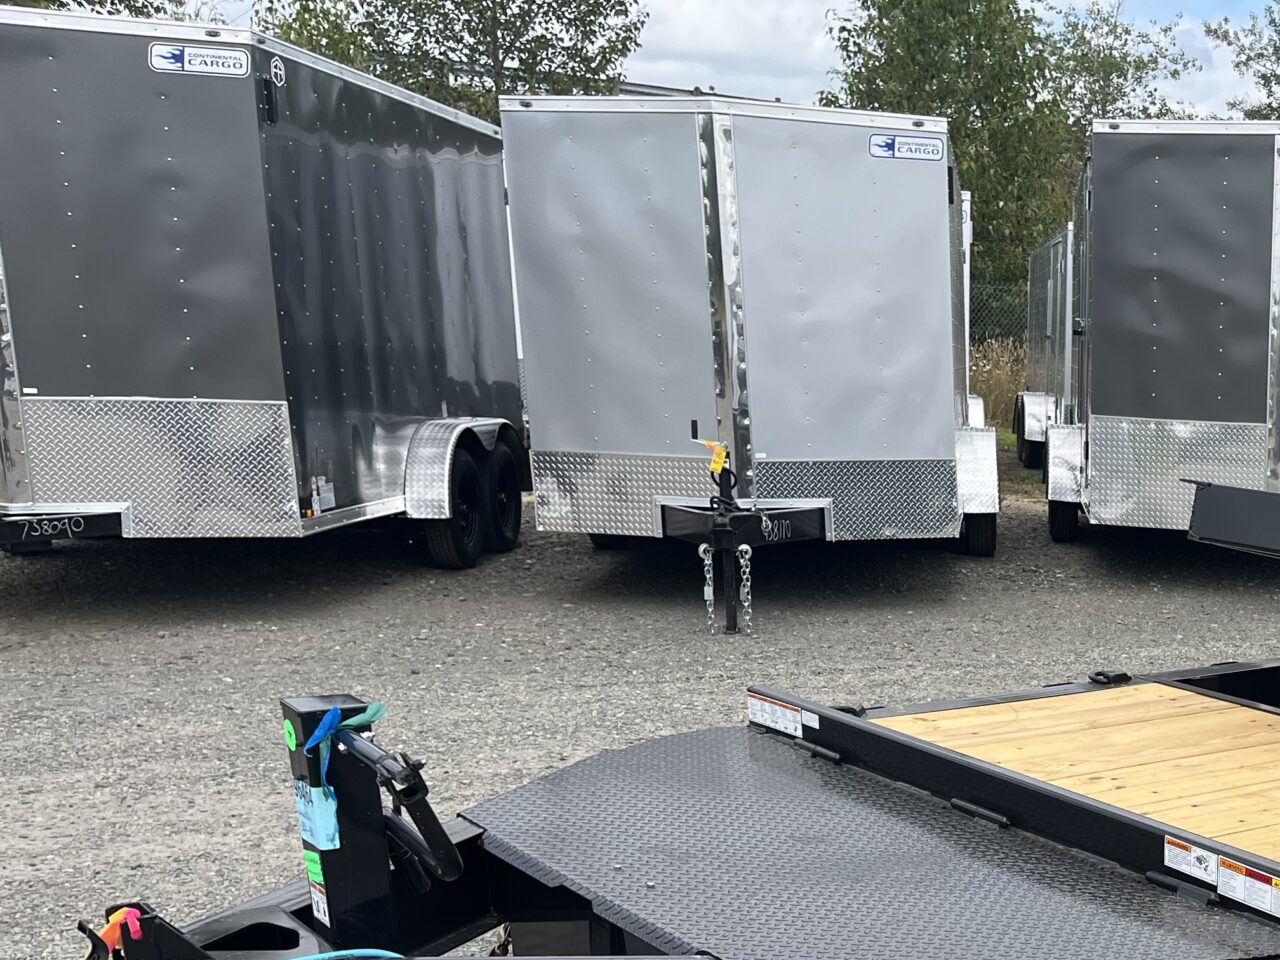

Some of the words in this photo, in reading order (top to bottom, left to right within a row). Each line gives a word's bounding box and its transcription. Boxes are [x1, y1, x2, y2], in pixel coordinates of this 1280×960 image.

[188, 52, 242, 61] CONTINENTAL
[188, 58, 243, 69] CARGO
[897, 146, 940, 155] CARGO
[17, 516, 84, 541] 738090
